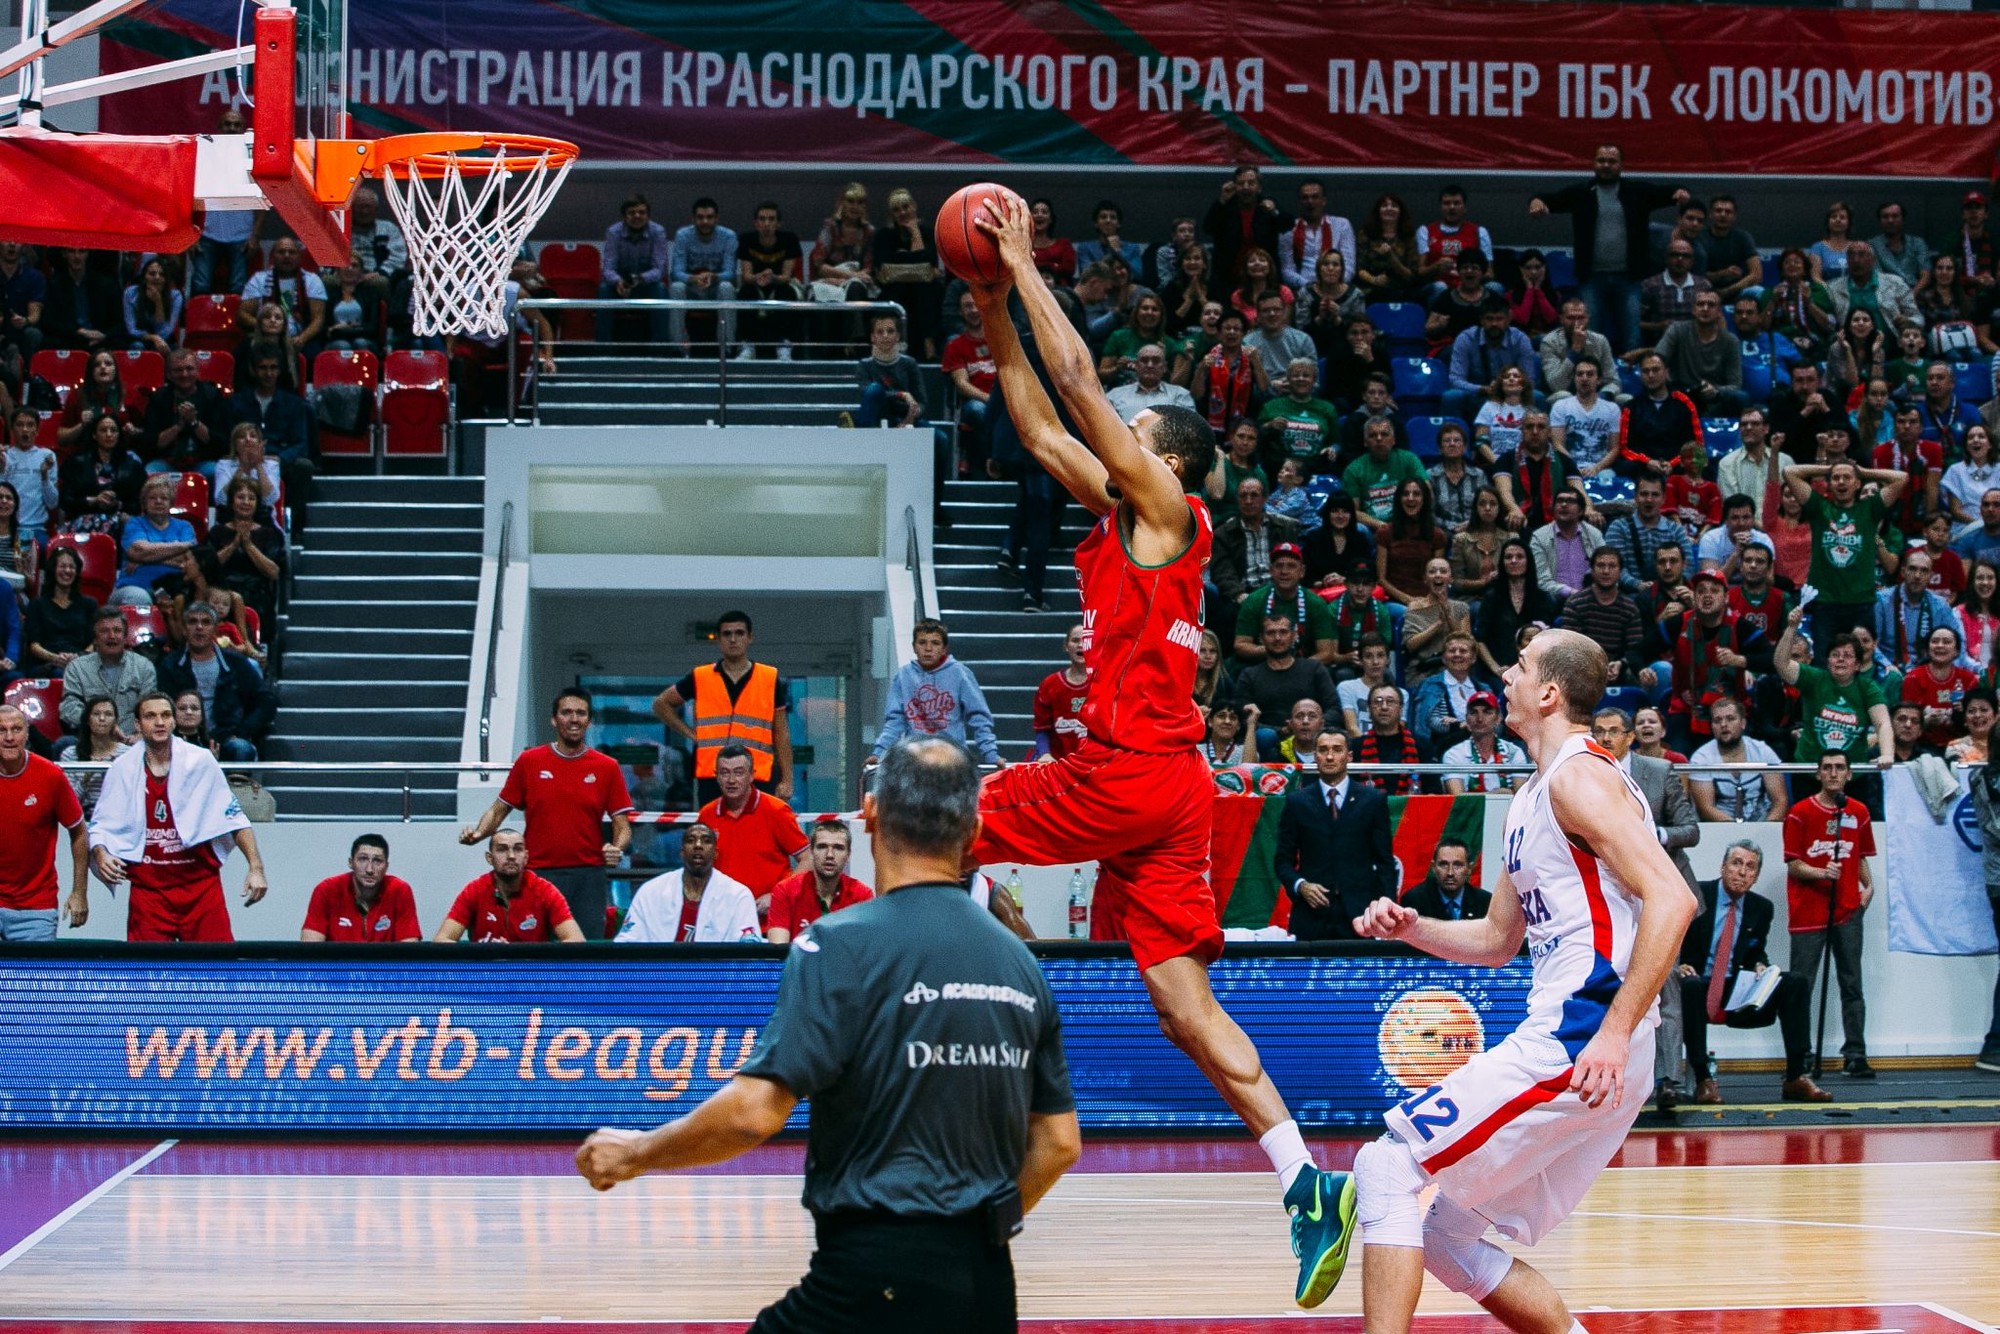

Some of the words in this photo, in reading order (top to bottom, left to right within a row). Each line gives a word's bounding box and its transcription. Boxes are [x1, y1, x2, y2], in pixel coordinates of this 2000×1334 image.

[661, 51, 1118, 118] КРАСНОДАРСКОГО
[1137, 56, 1266, 112] КРАЯ
[1327, 58, 1540, 117] ПАРТНЕР
[1556, 63, 1653, 120] ПБК
[154, 800, 167, 823] 4
[1508, 826, 1524, 874] 12
[1400, 1085, 1459, 1143] 12
